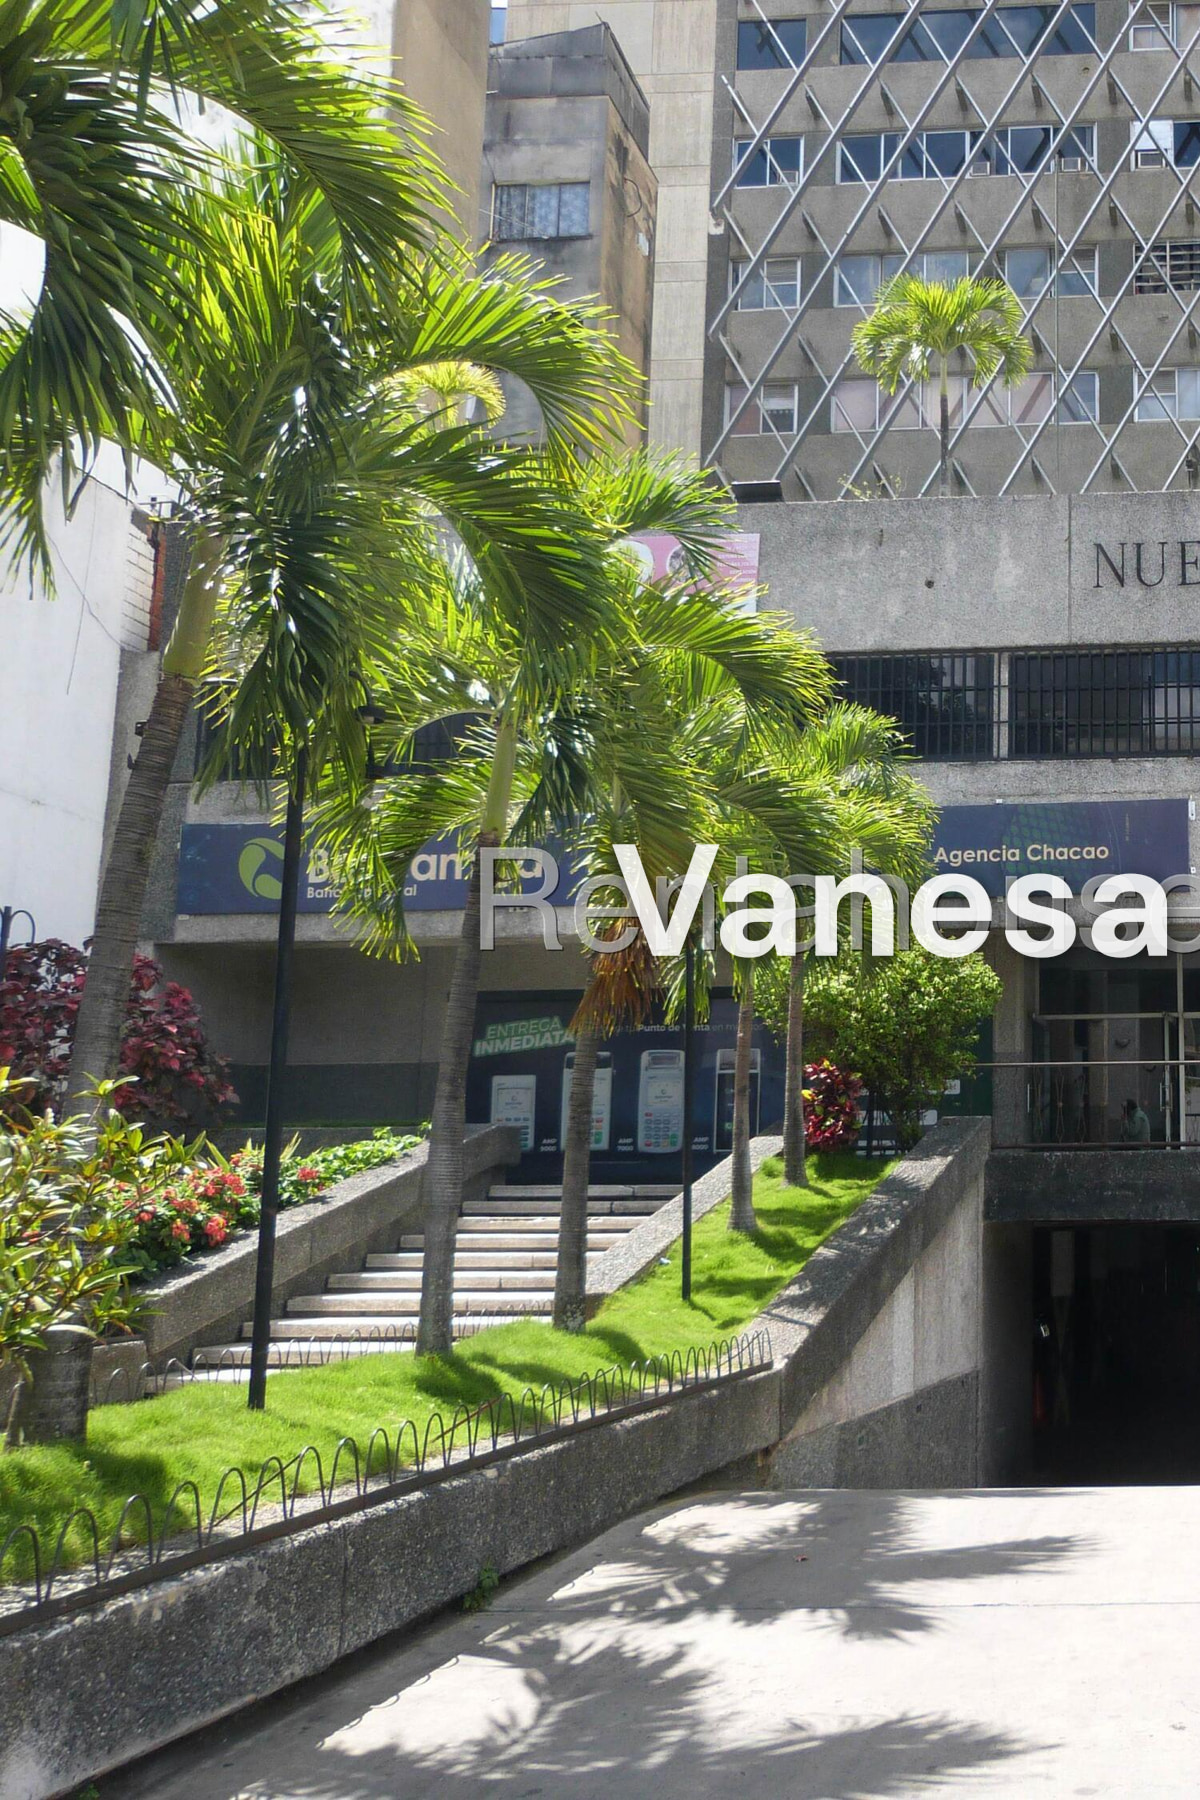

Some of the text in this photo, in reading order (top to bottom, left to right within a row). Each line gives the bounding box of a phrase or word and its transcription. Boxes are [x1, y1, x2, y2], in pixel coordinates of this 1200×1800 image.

[934, 844, 1110, 867] Agencia Chacao
[306, 886, 346, 899] Banc
[486, 1015, 562, 1040] ENTREGA
[638, 1023, 665, 1032] Punto
[668, 1023, 680, 1031] de
[681, 1023, 710, 1032] Vnta
[474, 1032, 576, 1054] INMEDIATA
